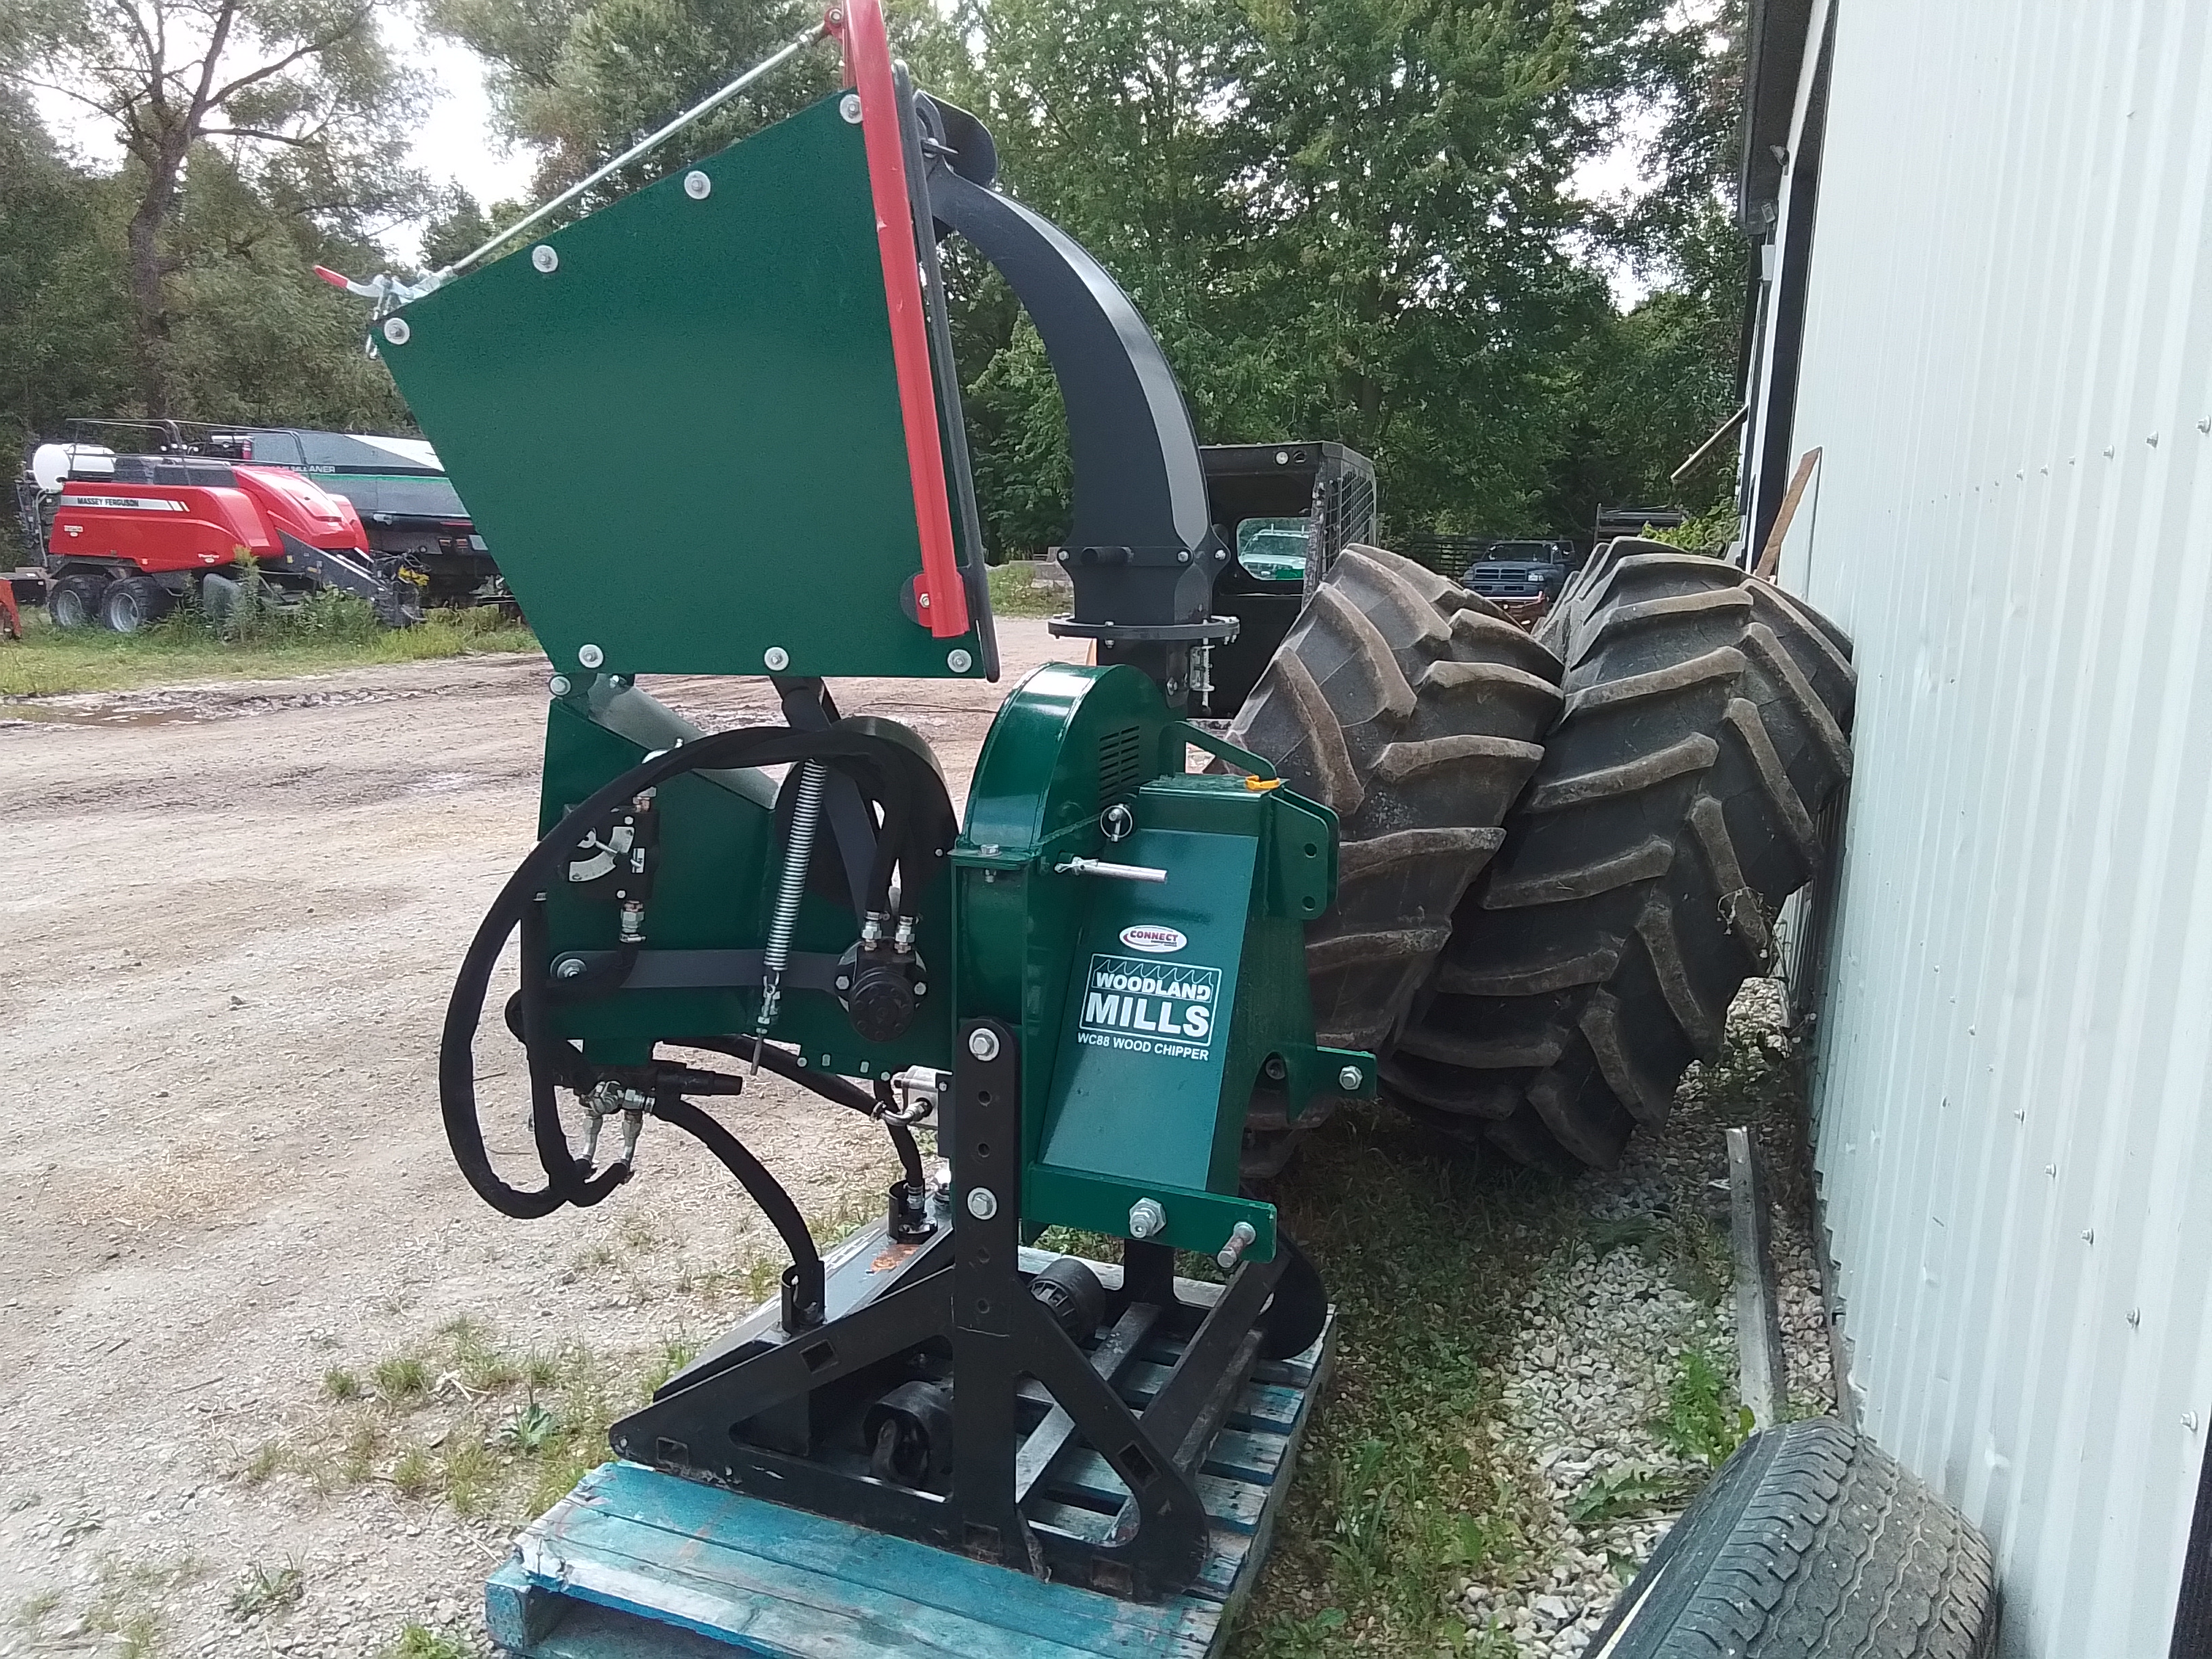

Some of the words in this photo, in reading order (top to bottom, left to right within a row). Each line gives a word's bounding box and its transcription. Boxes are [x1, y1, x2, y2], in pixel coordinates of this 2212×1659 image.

[77, 497, 103, 506] MASSEY
[105, 499, 139, 507] FERGUSON
[1130, 930, 1179, 941] CONNECT
[1096, 972, 1211, 1000] WOODLAND
[1085, 992, 1210, 1037] MILLS
[1078, 1032, 1110, 1047] WC88
[1113, 1037, 1151, 1052] WOOD
[1154, 1044, 1209, 1061] CHIPPER
